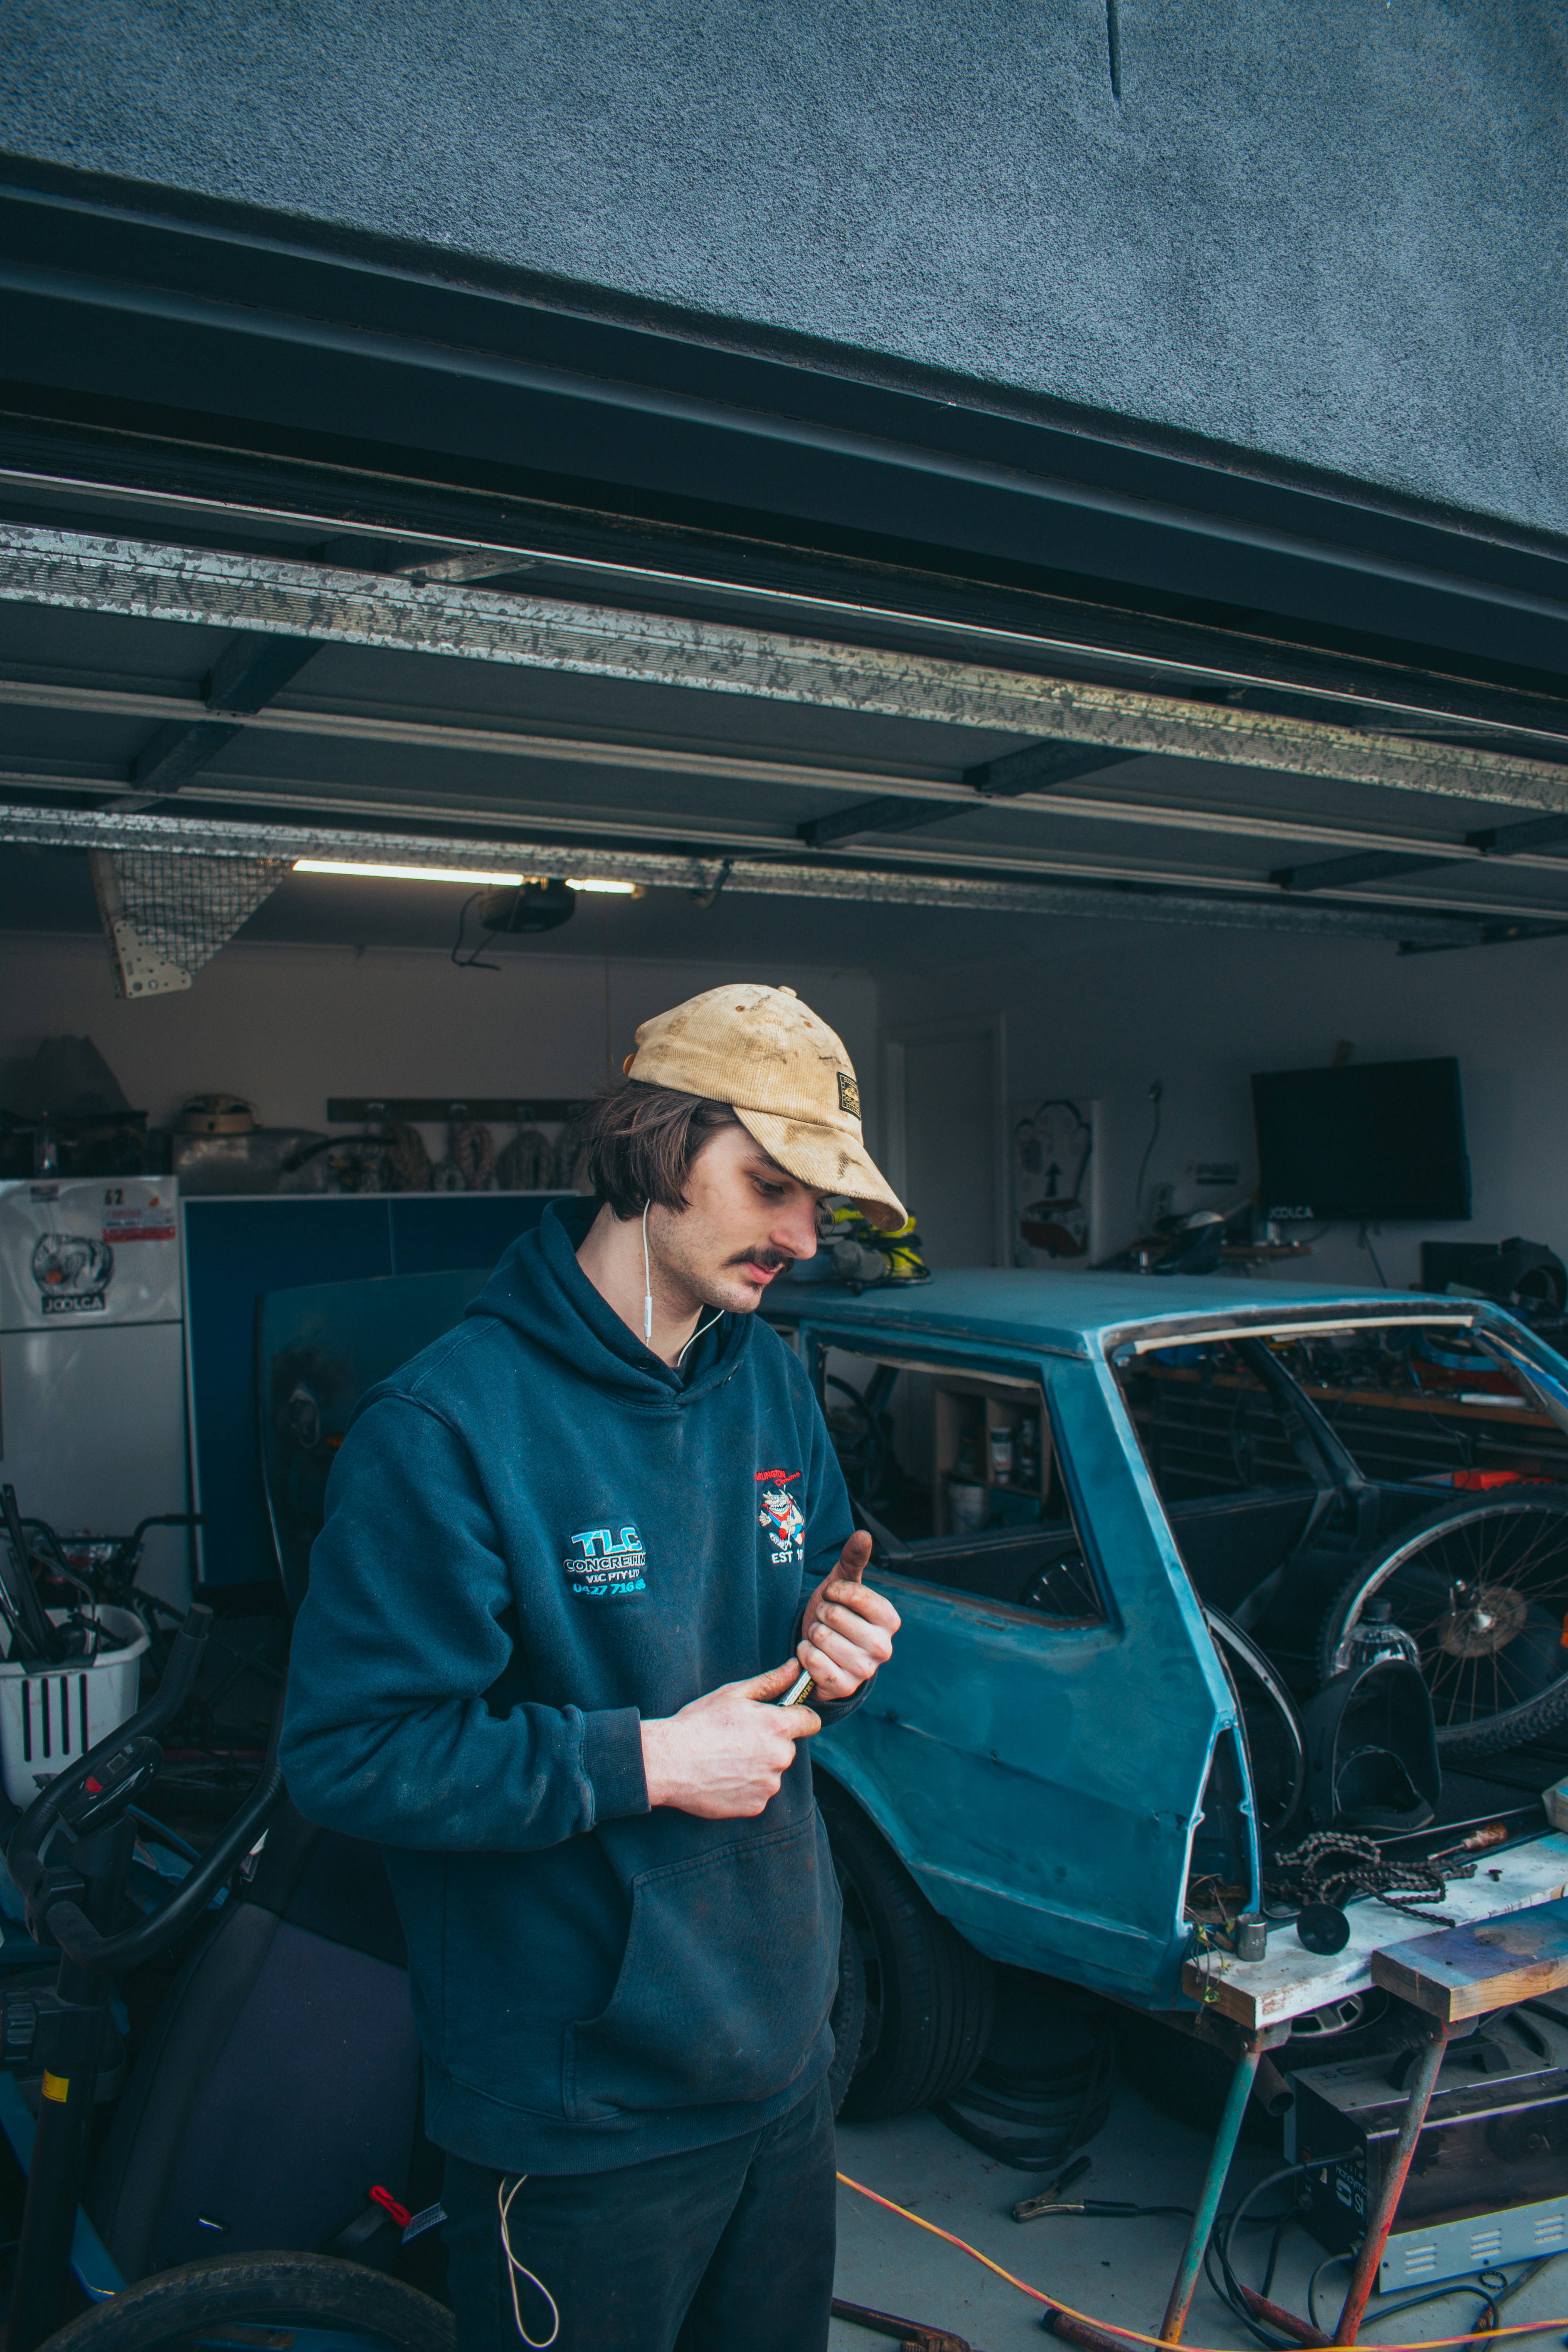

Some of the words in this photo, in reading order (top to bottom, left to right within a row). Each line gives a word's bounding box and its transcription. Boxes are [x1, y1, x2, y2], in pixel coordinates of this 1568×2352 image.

[44, 1296, 102, 1312] JOOLCA
[755, 1470, 786, 1481] ARLINGTON
[571, 1526, 643, 1557] TLC
[563, 1552, 646, 1572] CONCRETIN
[771, 1550, 793, 1564] EST
[586, 1573, 606, 1583] VIC
[608, 1570, 628, 1581] PTY
[573, 1583, 608, 1595] 0427
[1336, 2164, 1367, 2196] Handyma
